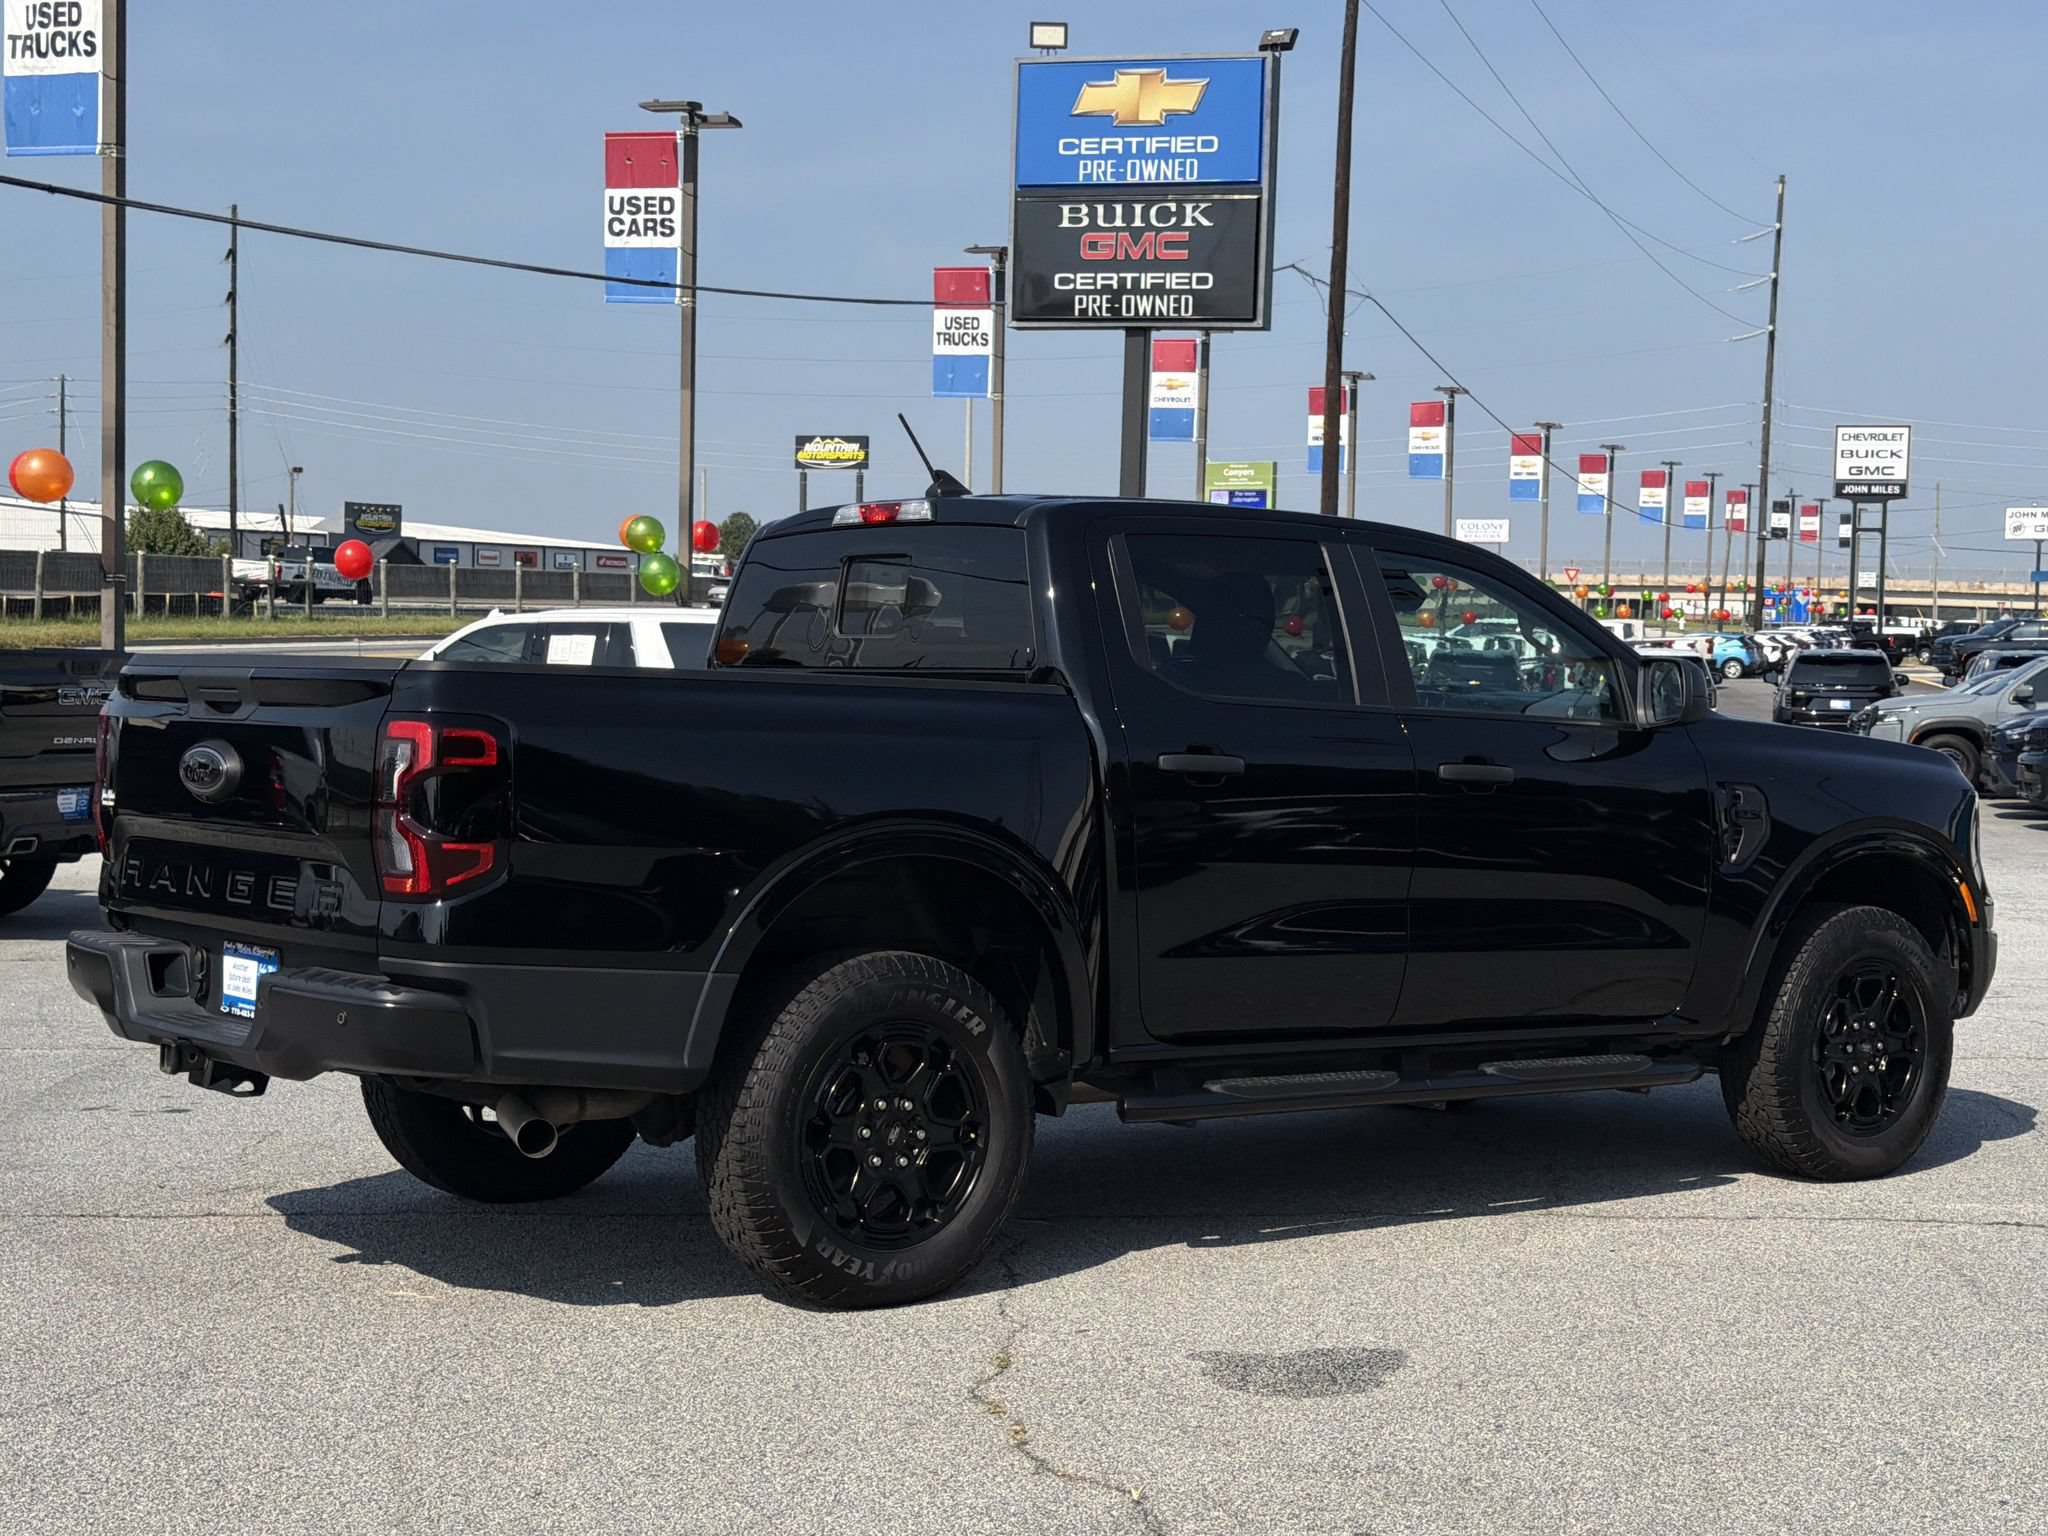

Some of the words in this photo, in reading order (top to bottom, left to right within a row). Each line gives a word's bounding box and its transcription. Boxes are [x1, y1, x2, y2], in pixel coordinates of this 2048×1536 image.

[26, 1, 82, 31] USED
[7, 30, 97, 60] TRUCKS
[1057, 135, 1219, 156] CERTIFIED
[1078, 158, 1199, 182] PRE-OWNED
[608, 195, 675, 216] USED
[1057, 202, 1214, 228] BUICK
[607, 216, 676, 238] CARS
[1079, 231, 1189, 260] GMC
[1053, 272, 1214, 290] CERTIFIED
[1073, 294, 1193, 317] PRE-OWNED
[944, 316, 980, 331] USED
[936, 331, 989, 347] TRUCKS
[1841, 433, 1904, 442] CHEVROLET
[798, 451, 865, 460] MOTORSPORTS
[803, 442, 860, 452] MOUNTAIN
[1840, 449, 1904, 459] BUICK
[1223, 468, 1255, 477] Conyers
[1848, 466, 1895, 476] GMC
[1842, 485, 1868, 494] JOHN
[1871, 485, 1900, 494] MILES
[2008, 511, 2038, 519] JOHN
[1460, 522, 1505, 530] COLONY
[58, 688, 113, 706] GMC
[121, 857, 344, 917] RANGER
